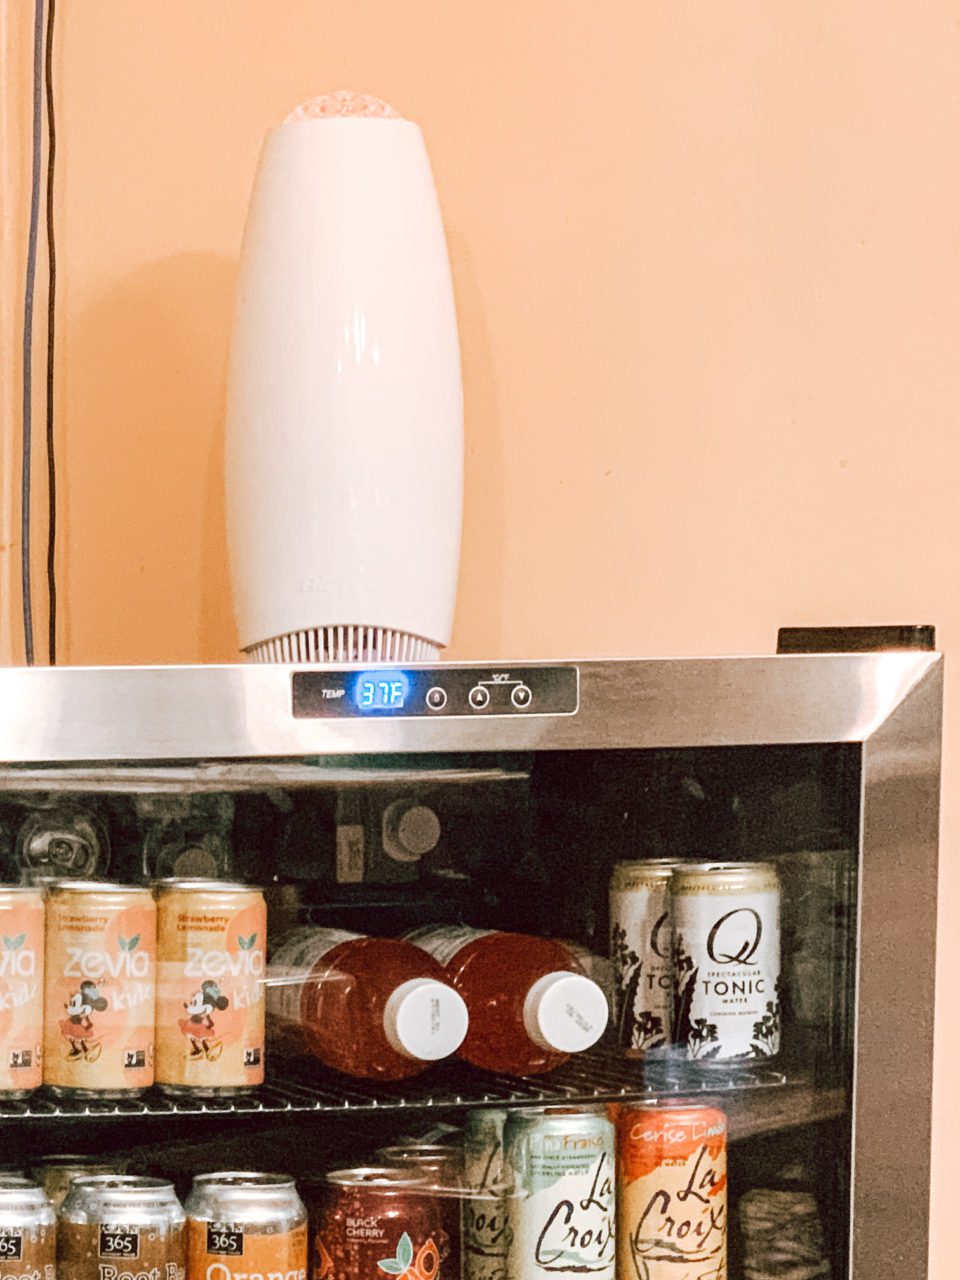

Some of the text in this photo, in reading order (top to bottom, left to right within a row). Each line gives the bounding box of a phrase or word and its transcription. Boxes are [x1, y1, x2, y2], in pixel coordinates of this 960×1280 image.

[321, 689, 345, 699] TEMP
[177, 913, 230, 926] Strawberry
[177, 924, 226, 933] Lemonade
[706, 907, 763, 967] Q
[64, 946, 150, 978] zevia
[183, 946, 264, 977] zevia
[702, 979, 766, 995] TONIC
[580, 1151, 613, 1213] La
[676, 1143, 718, 1205] La
[346, 1218, 378, 1228] BLACK
[635, 1189, 726, 1254] Croix
[346, 1228, 385, 1238] CHERRY
[104, 1234, 133, 1253] 365
[211, 1234, 238, 1251] 365
